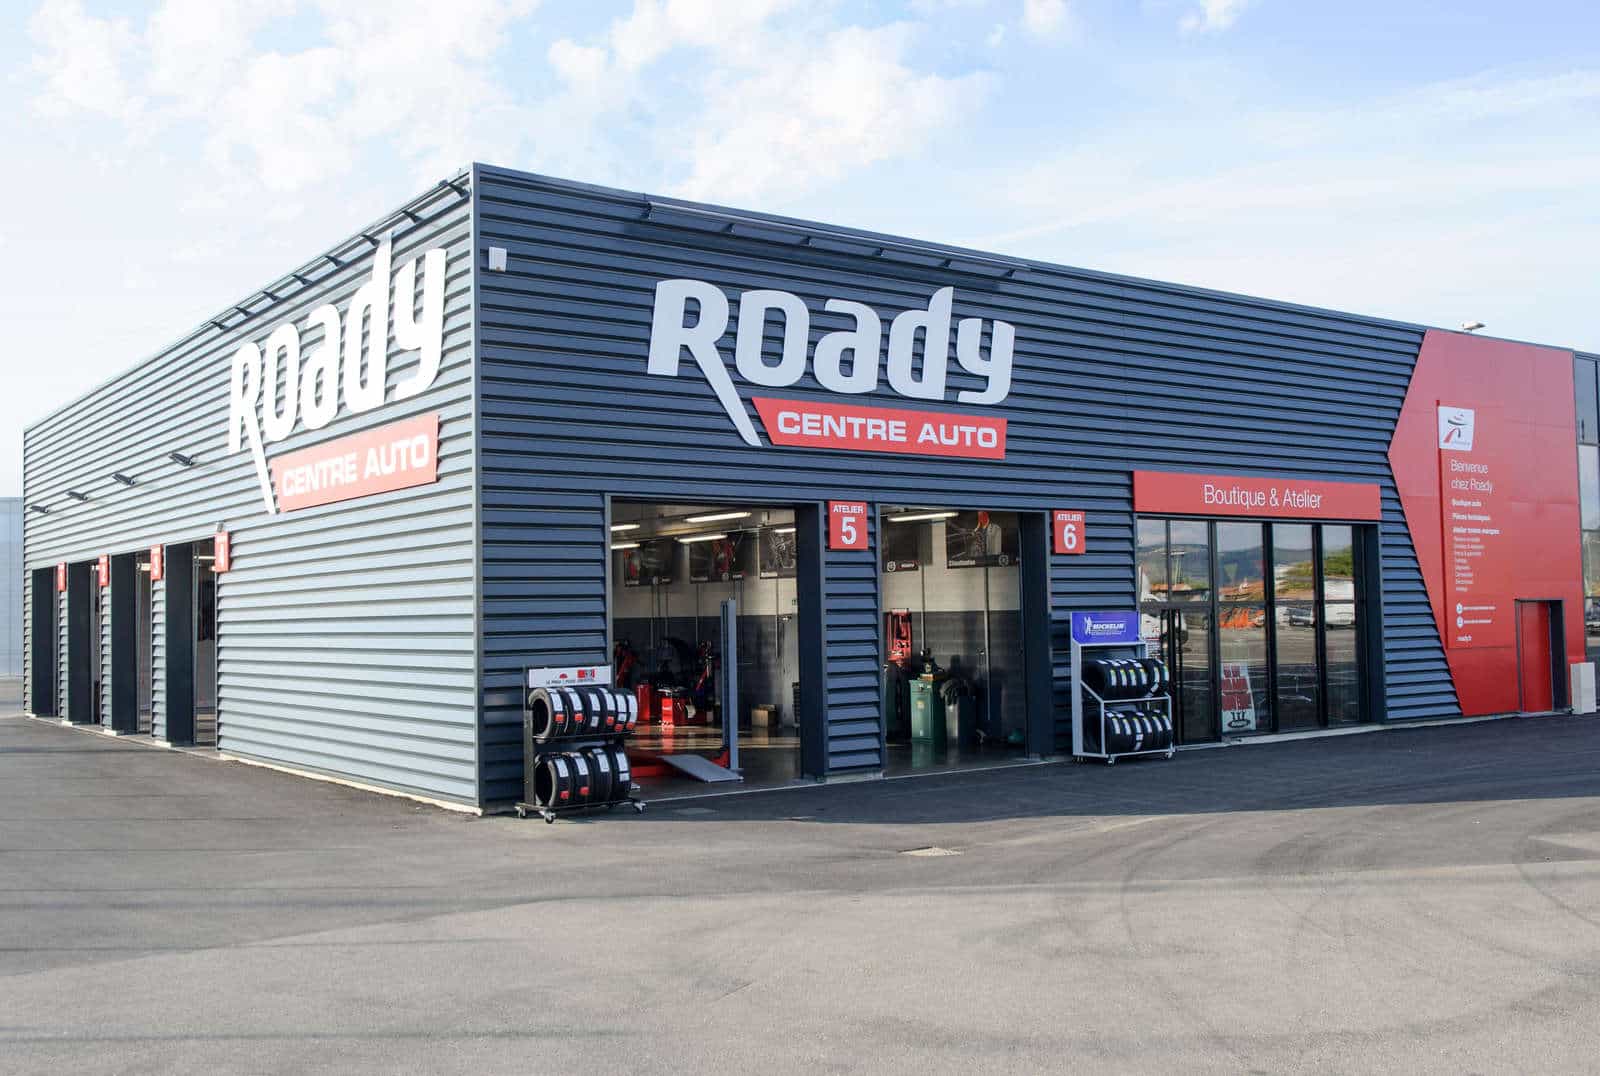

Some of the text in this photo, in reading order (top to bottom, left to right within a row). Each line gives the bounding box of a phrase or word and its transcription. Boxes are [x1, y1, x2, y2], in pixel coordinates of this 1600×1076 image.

[227, 229, 447, 514] Roady
[647, 279, 1015, 447] Roady
[776, 410, 998, 449] CENTRE AUTO
[281, 433, 430, 497] CENTRE AUTO
[833, 504, 864, 514] ATELIER
[1204, 484, 1322, 510] Boutique & Atelier
[841, 516, 857, 545] 5
[1056, 513, 1082, 522] ATELIER
[1063, 523, 1077, 550] 6
